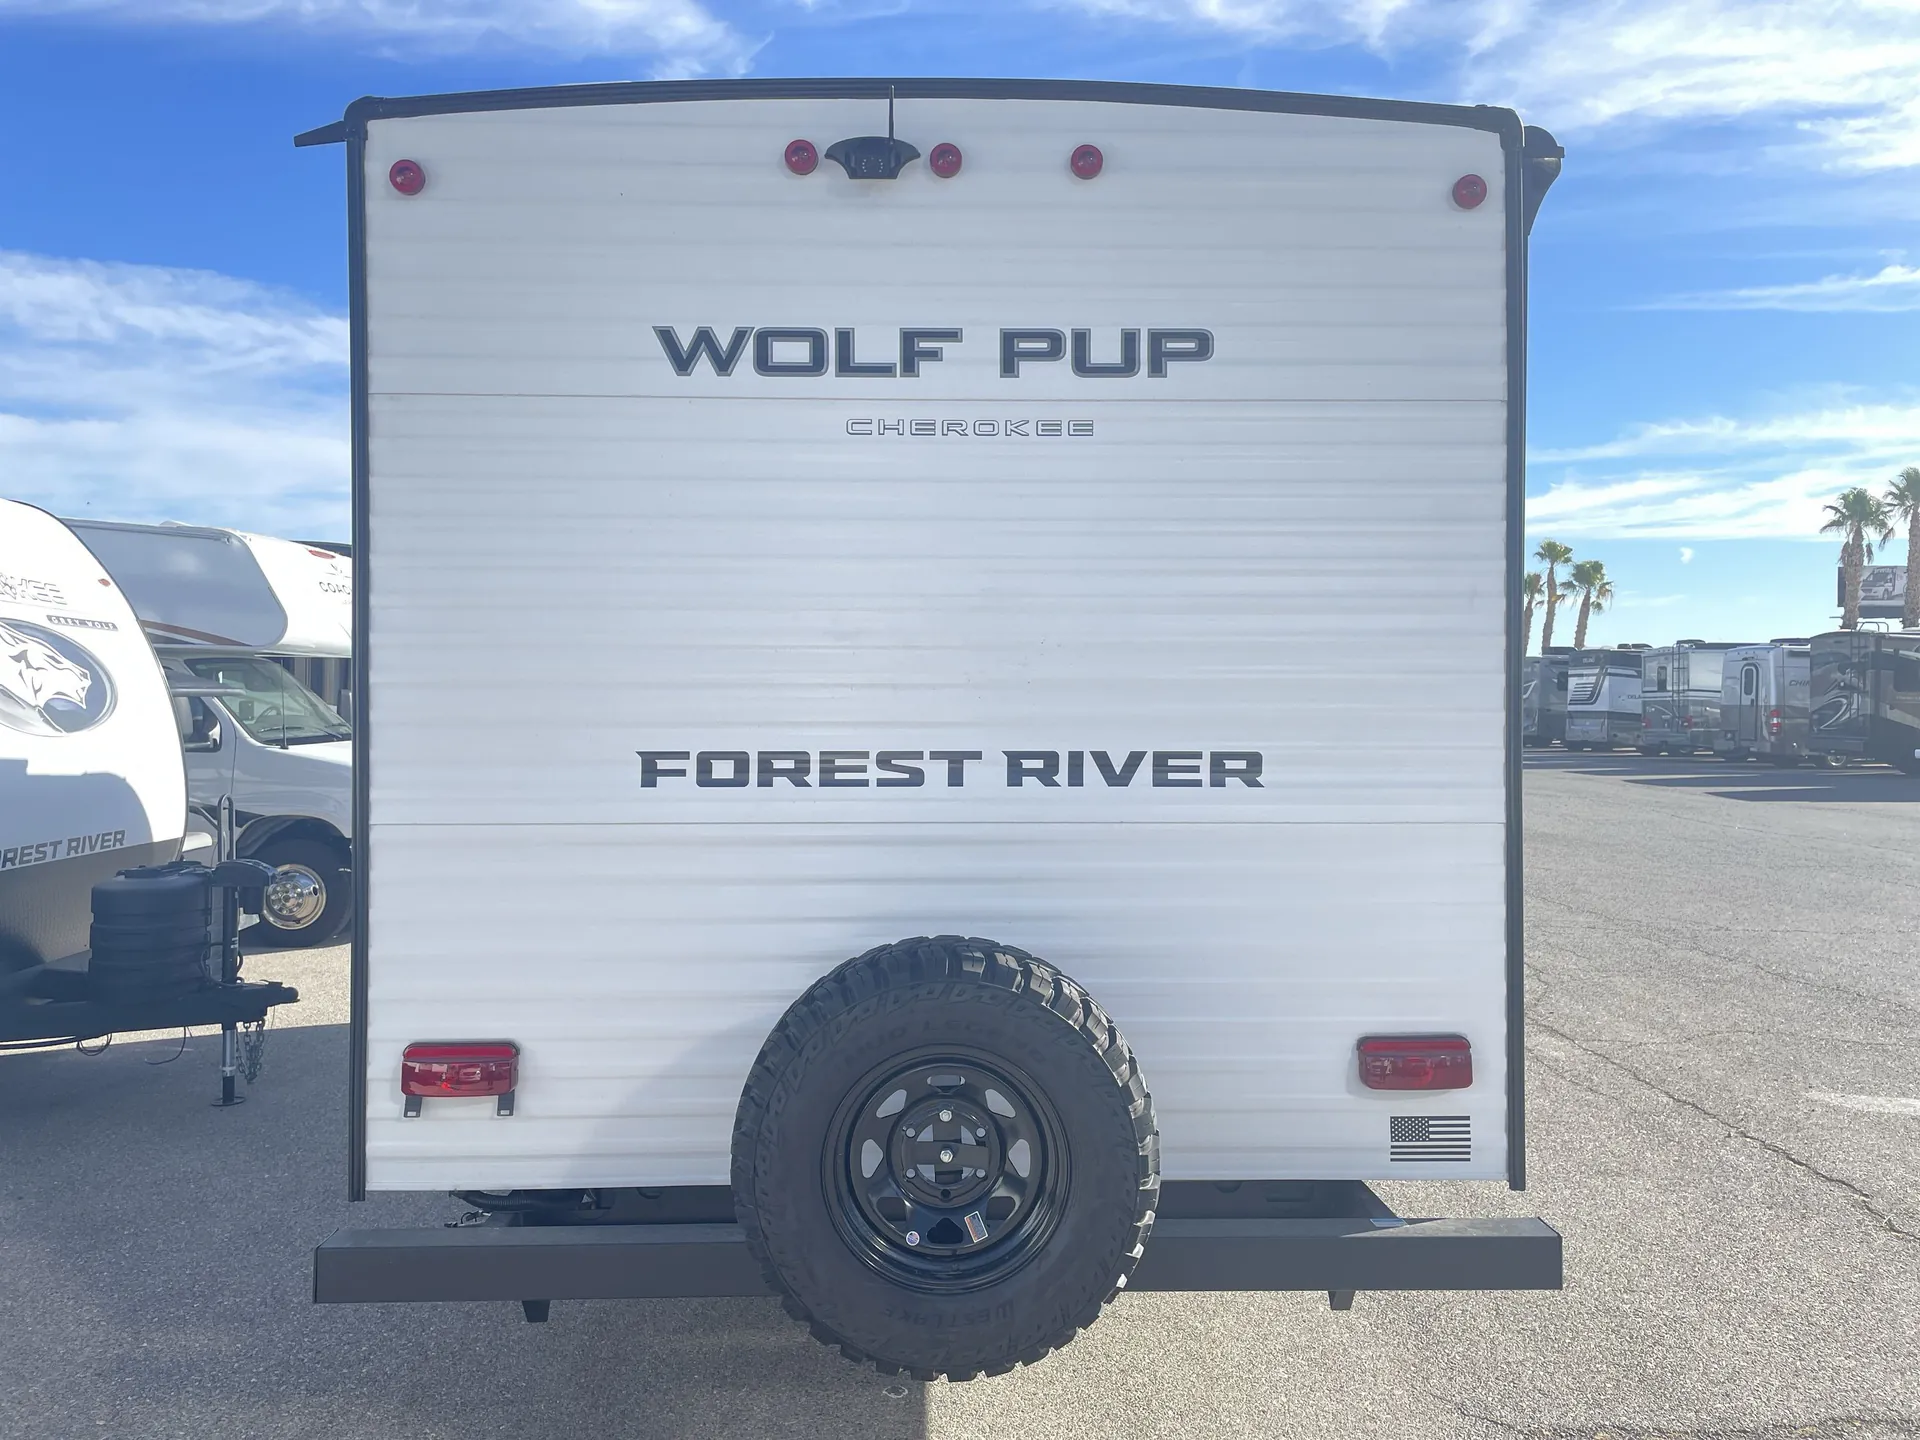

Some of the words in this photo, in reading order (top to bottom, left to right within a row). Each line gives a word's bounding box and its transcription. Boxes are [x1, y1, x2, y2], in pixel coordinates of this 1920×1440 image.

[652, 326, 964, 378] WOLF
[1000, 327, 1215, 378] PUP
[845, 417, 1095, 437] CHEROKEE
[319, 581, 352, 595] COAC
[51, 615, 81, 626] GREY
[85, 620, 114, 630] WOLF
[634, 750, 983, 788] FOREST
[1001, 750, 1266, 788] RIVER
[0, 840, 62, 869] REST
[66, 829, 126, 857] RIVER
[882, 1298, 1017, 1329] WESTLAKE
